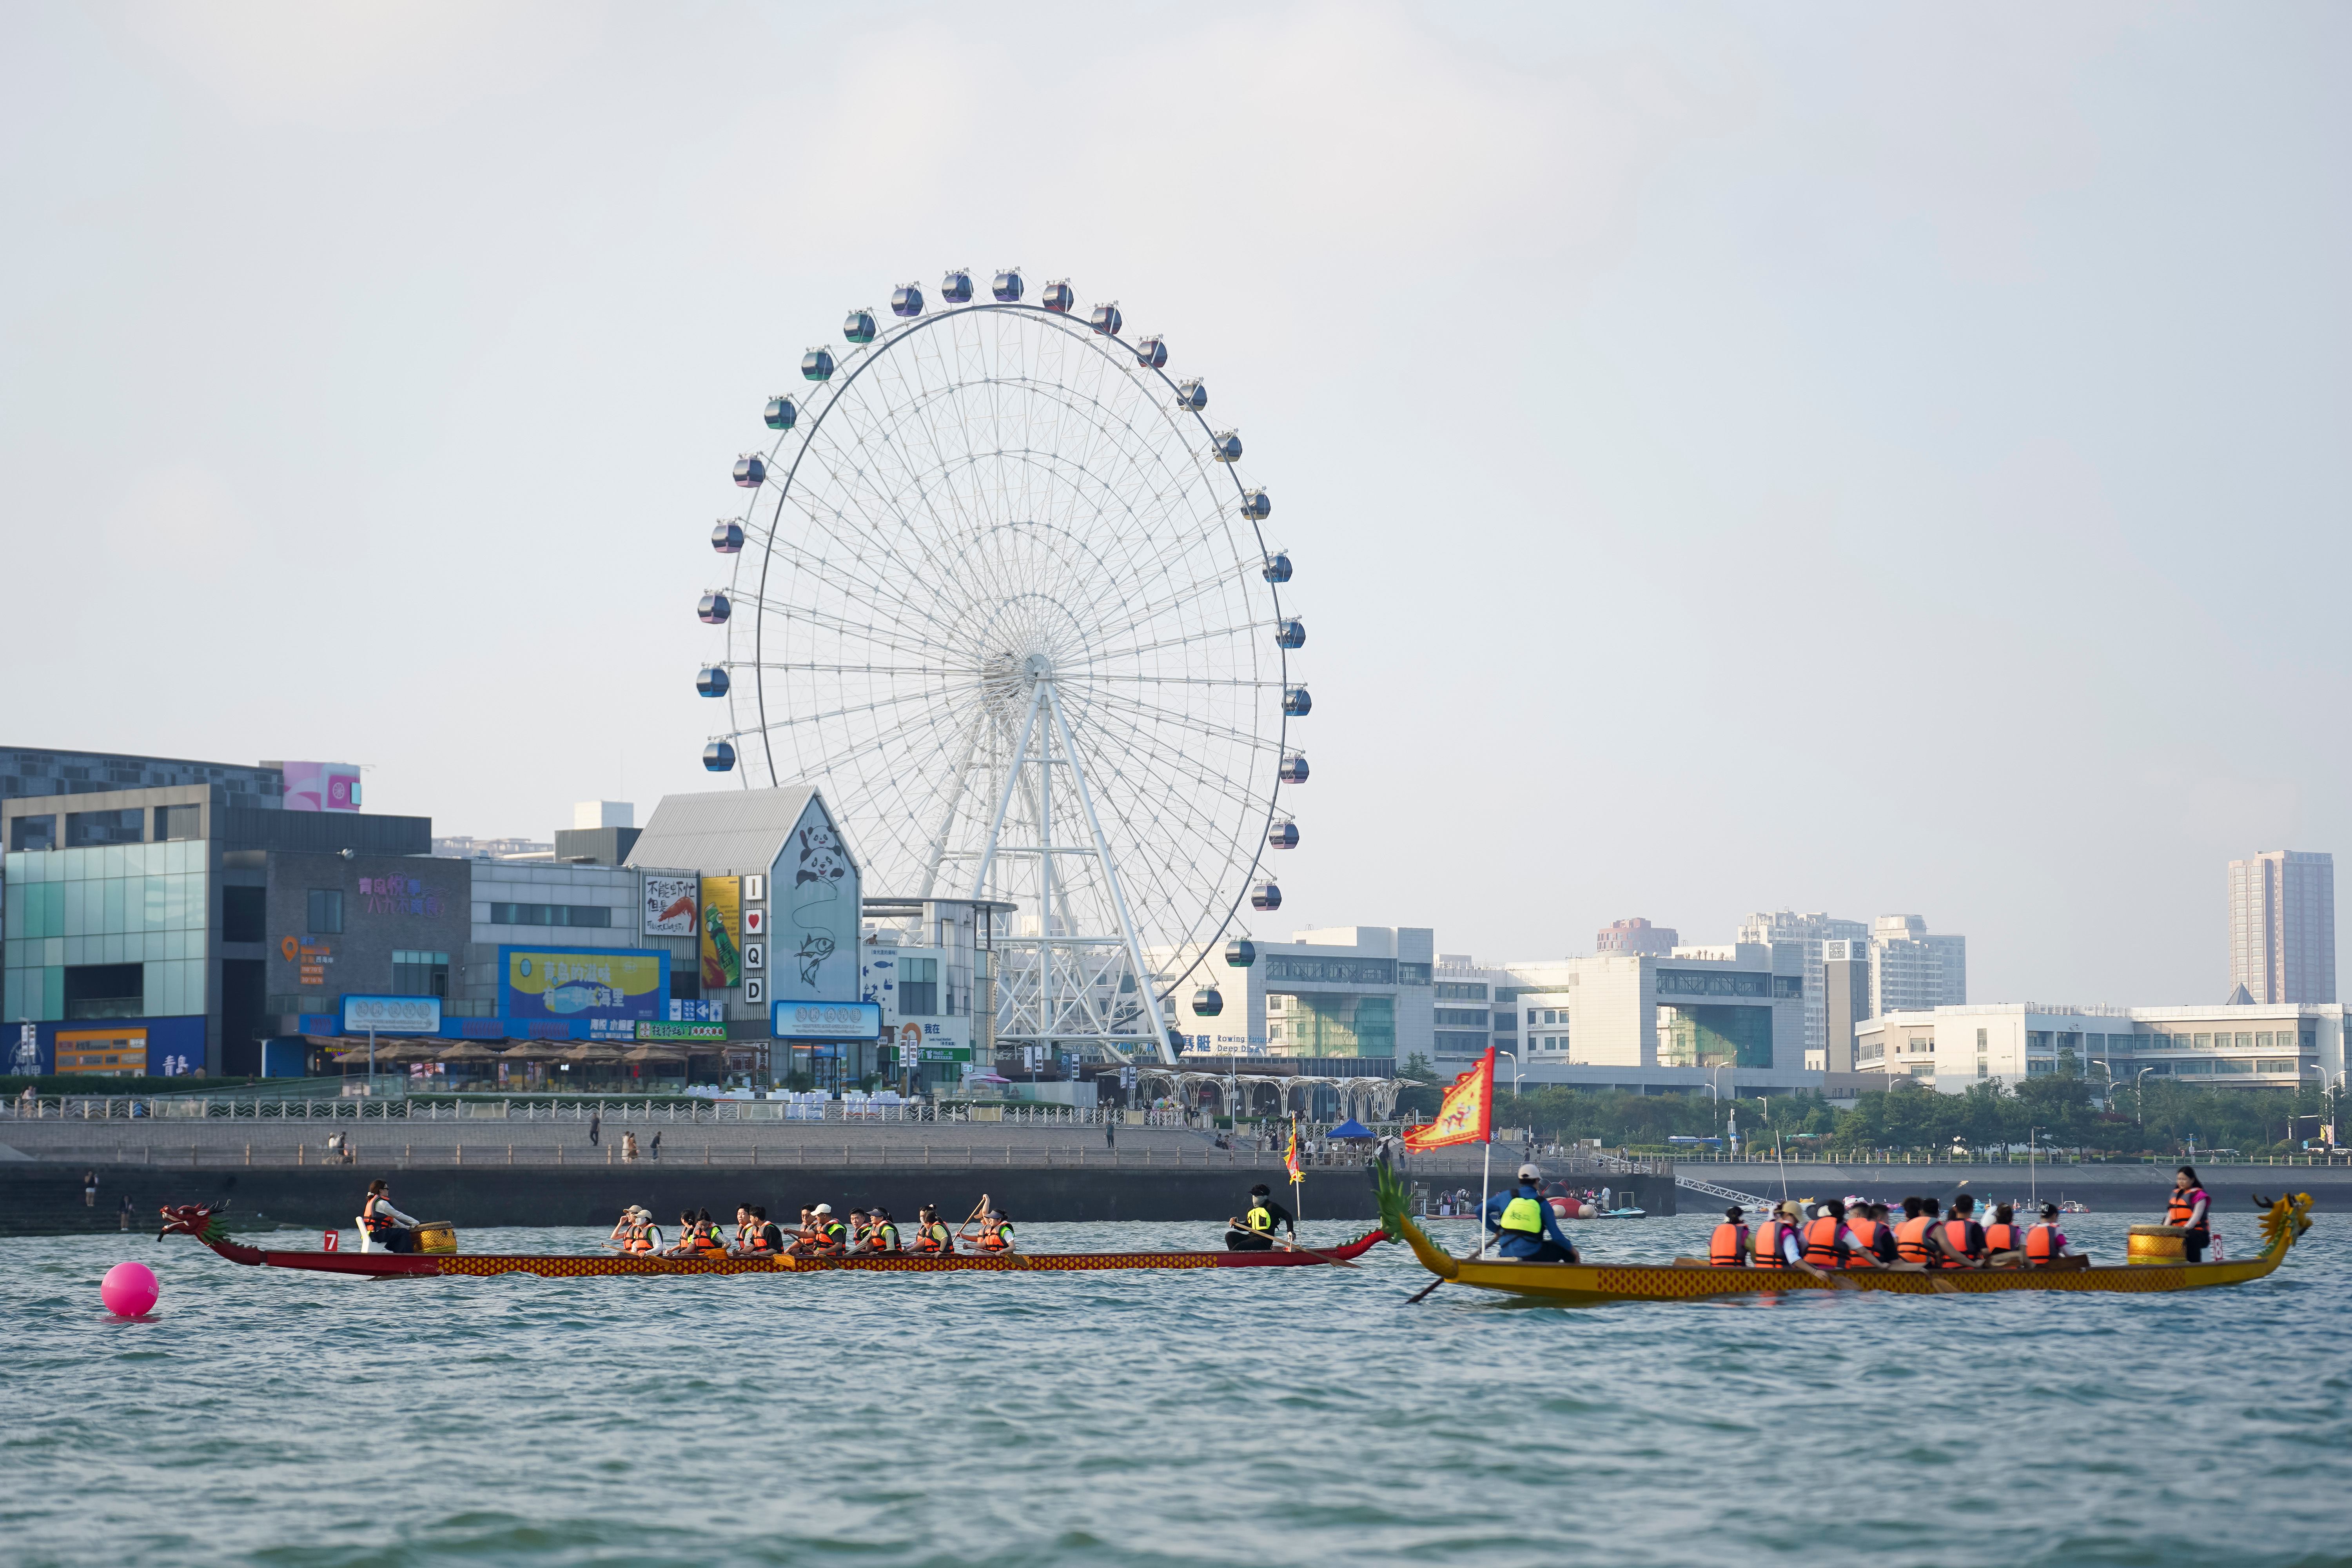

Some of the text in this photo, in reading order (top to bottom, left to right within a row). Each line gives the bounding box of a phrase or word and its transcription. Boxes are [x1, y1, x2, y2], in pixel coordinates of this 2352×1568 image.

[648, 881, 695, 897] 不能虾忙
[647, 897, 668, 913] 但是
[543, 962, 611, 982] 青岛的滋味
[543, 985, 624, 1007] 有一半在海里
[924, 1024, 940, 1034] 我在
[327, 1234, 336, 1250] 7
[2215, 1239, 2223, 1258] 8
